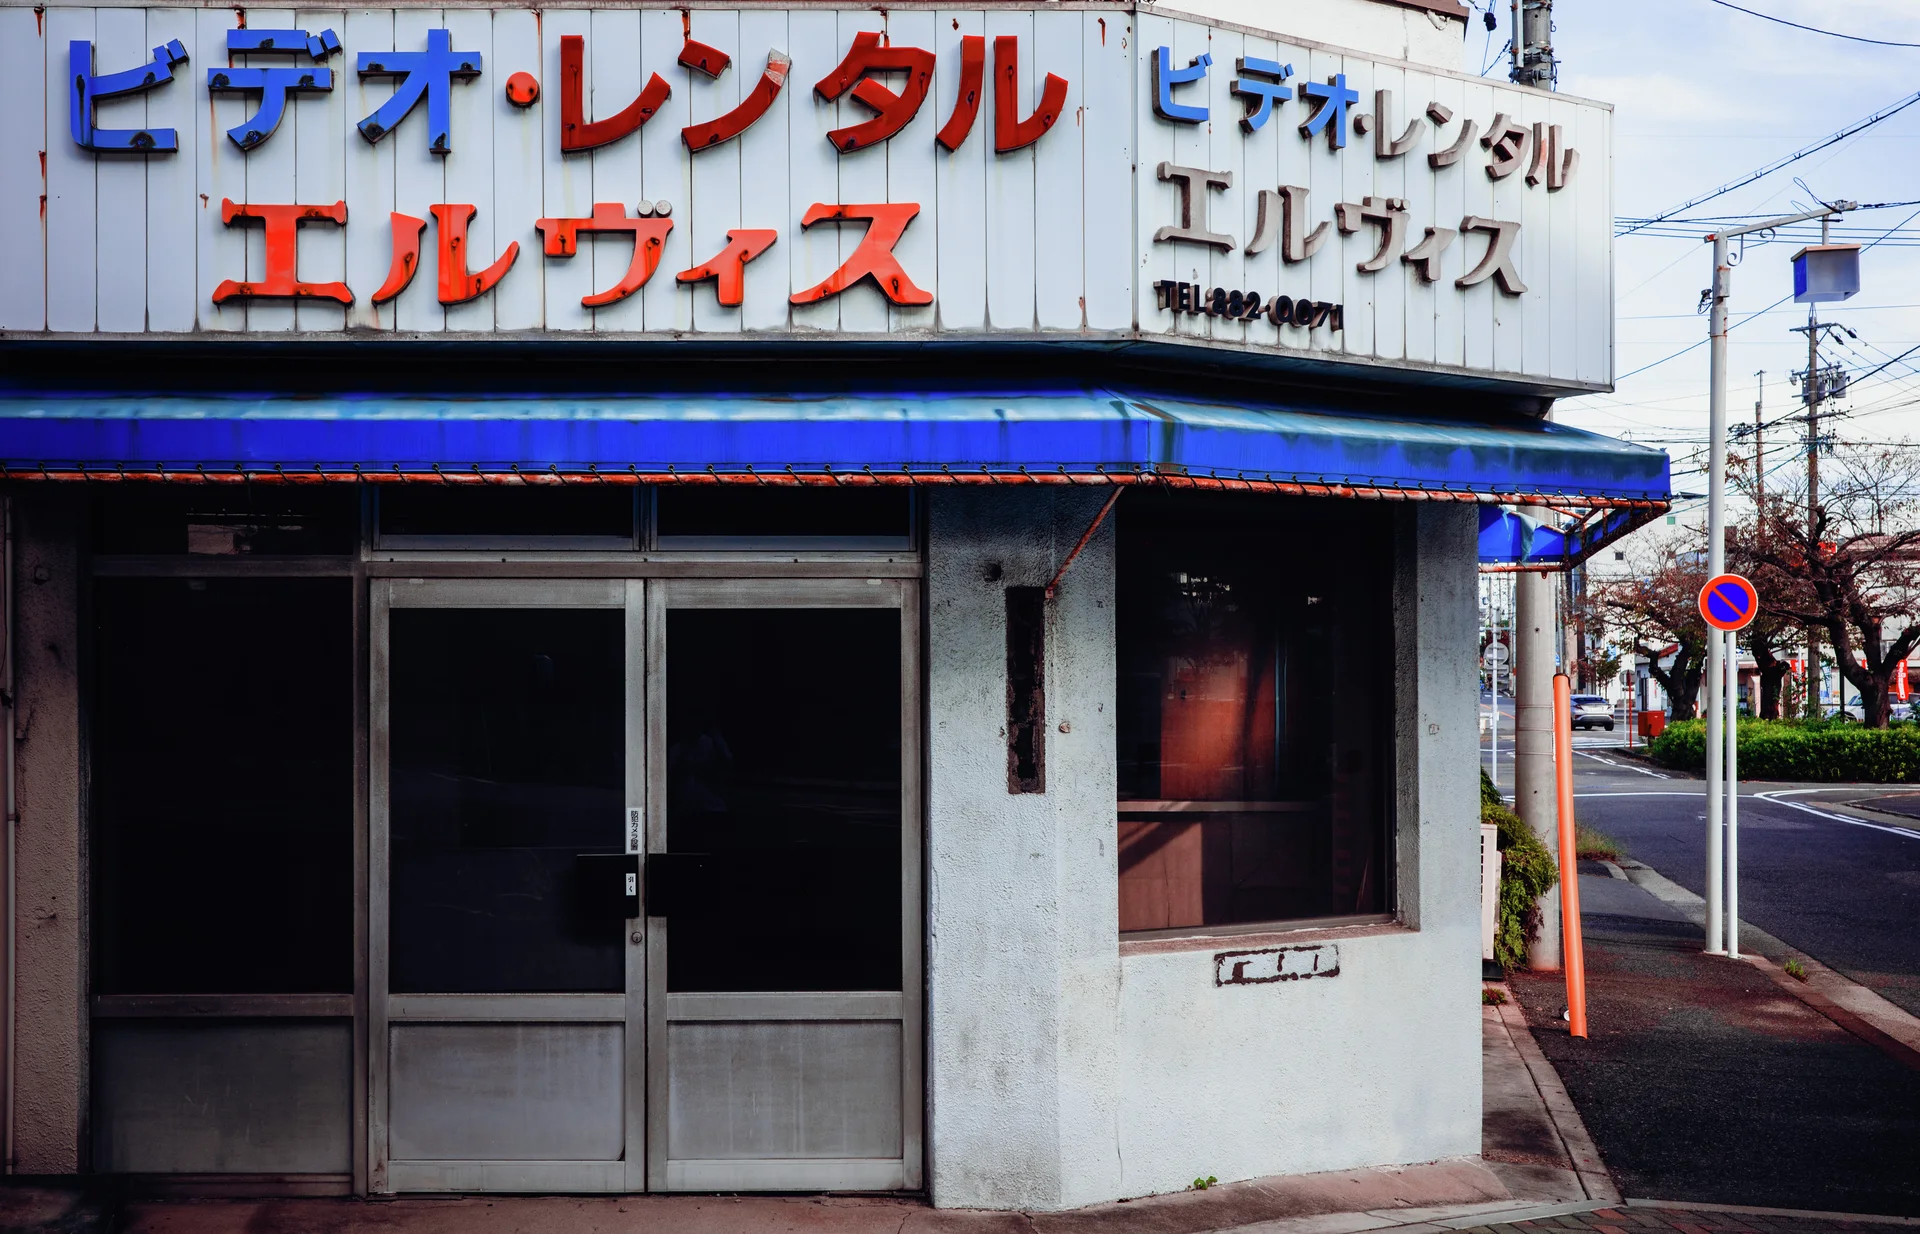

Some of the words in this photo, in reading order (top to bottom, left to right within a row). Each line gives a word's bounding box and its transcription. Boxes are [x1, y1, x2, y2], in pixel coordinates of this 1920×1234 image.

[69, 28, 1068, 154] ビデオ・レンタル
[1151, 46, 1580, 192] ビデオ・レンタル
[212, 198, 934, 306] エルヴィス
[1153, 161, 1528, 295] エルヴィス
